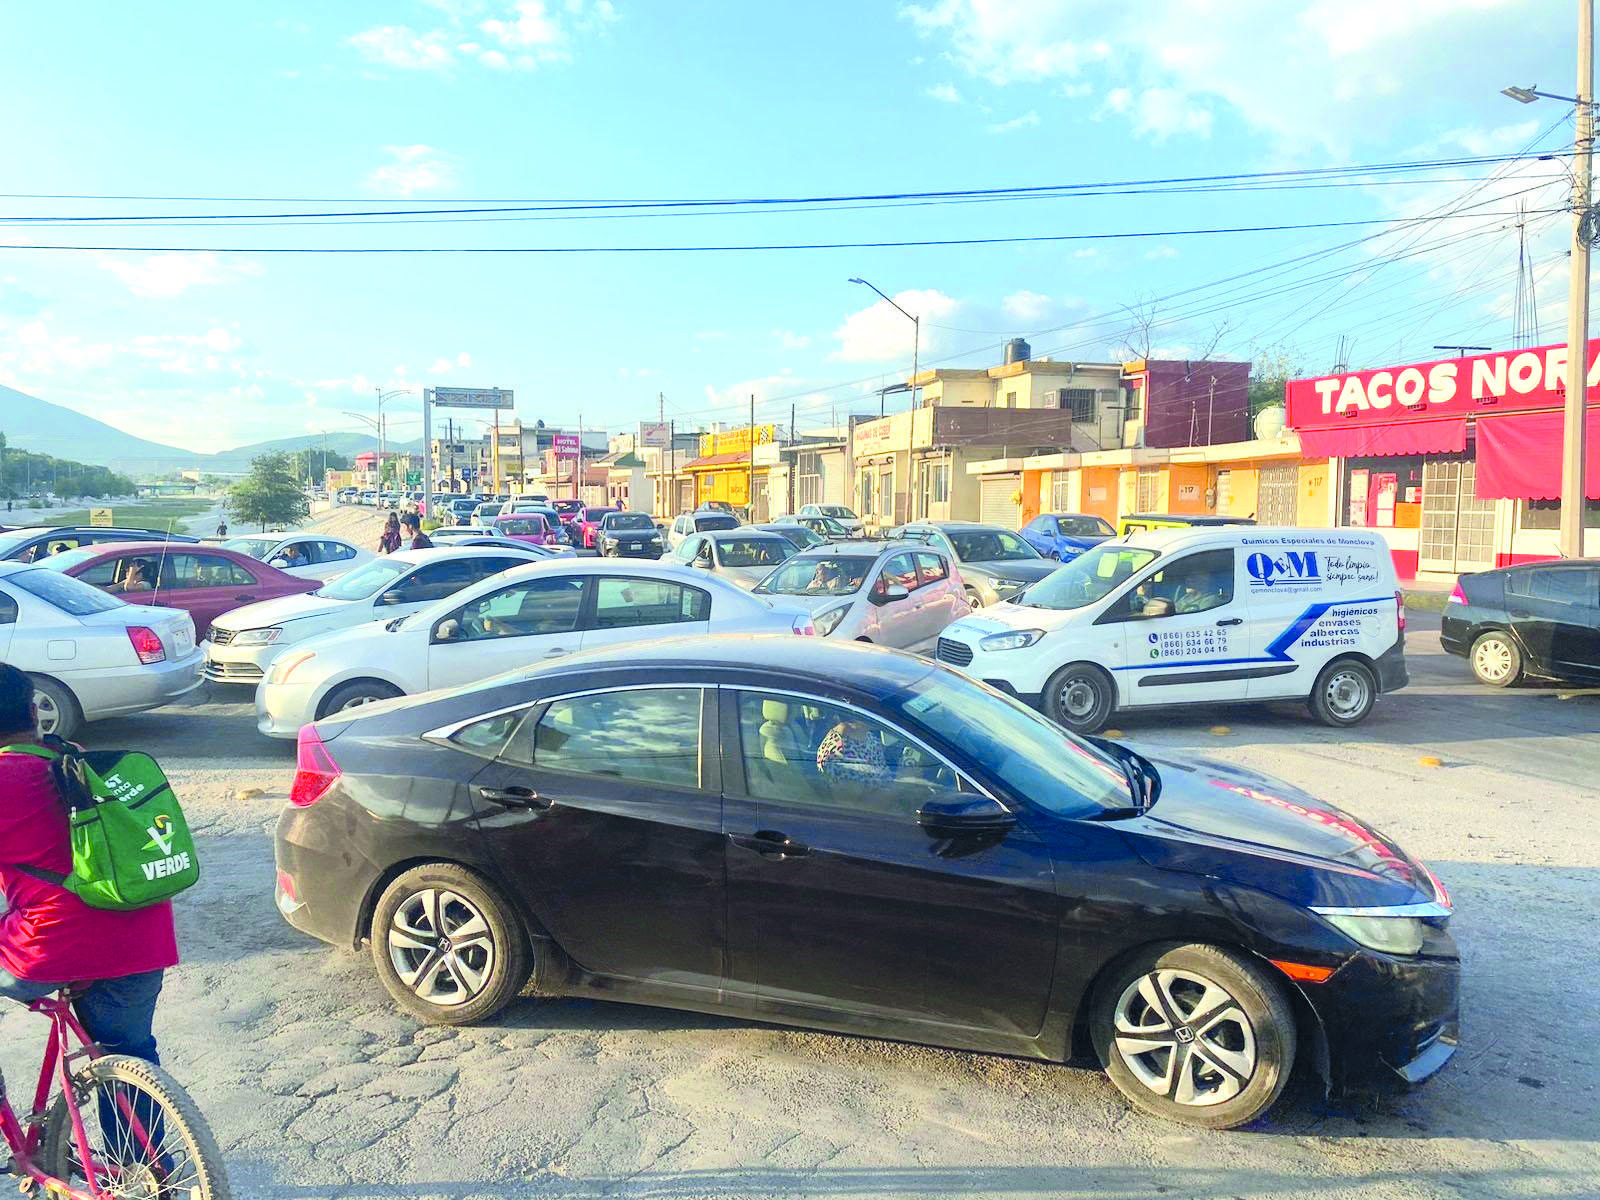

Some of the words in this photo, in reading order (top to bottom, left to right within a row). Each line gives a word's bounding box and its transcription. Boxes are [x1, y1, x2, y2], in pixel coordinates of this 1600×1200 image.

[1315, 362, 1458, 414] TACOS
[1338, 538, 1375, 546] Monclova
[1318, 619, 1361, 627] envases
[1160, 632, 1183, 641] (866)
[1185, 630, 1201, 638] 635
[1203, 629, 1214, 637] 42
[1216, 628, 1227, 636] 65
[1310, 628, 1360, 637] albercas
[1161, 640, 1183, 649] (866)
[1186, 639, 1201, 647] 634
[1217, 637, 1227, 645] 79
[1301, 638, 1356, 647] industrias
[1161, 648, 1184, 657] (866)
[1186, 647, 1202, 655] 204
[1204, 646, 1215, 654] 04
[1218, 645, 1228, 653] 16
[141, 851, 191, 880] VERDE
